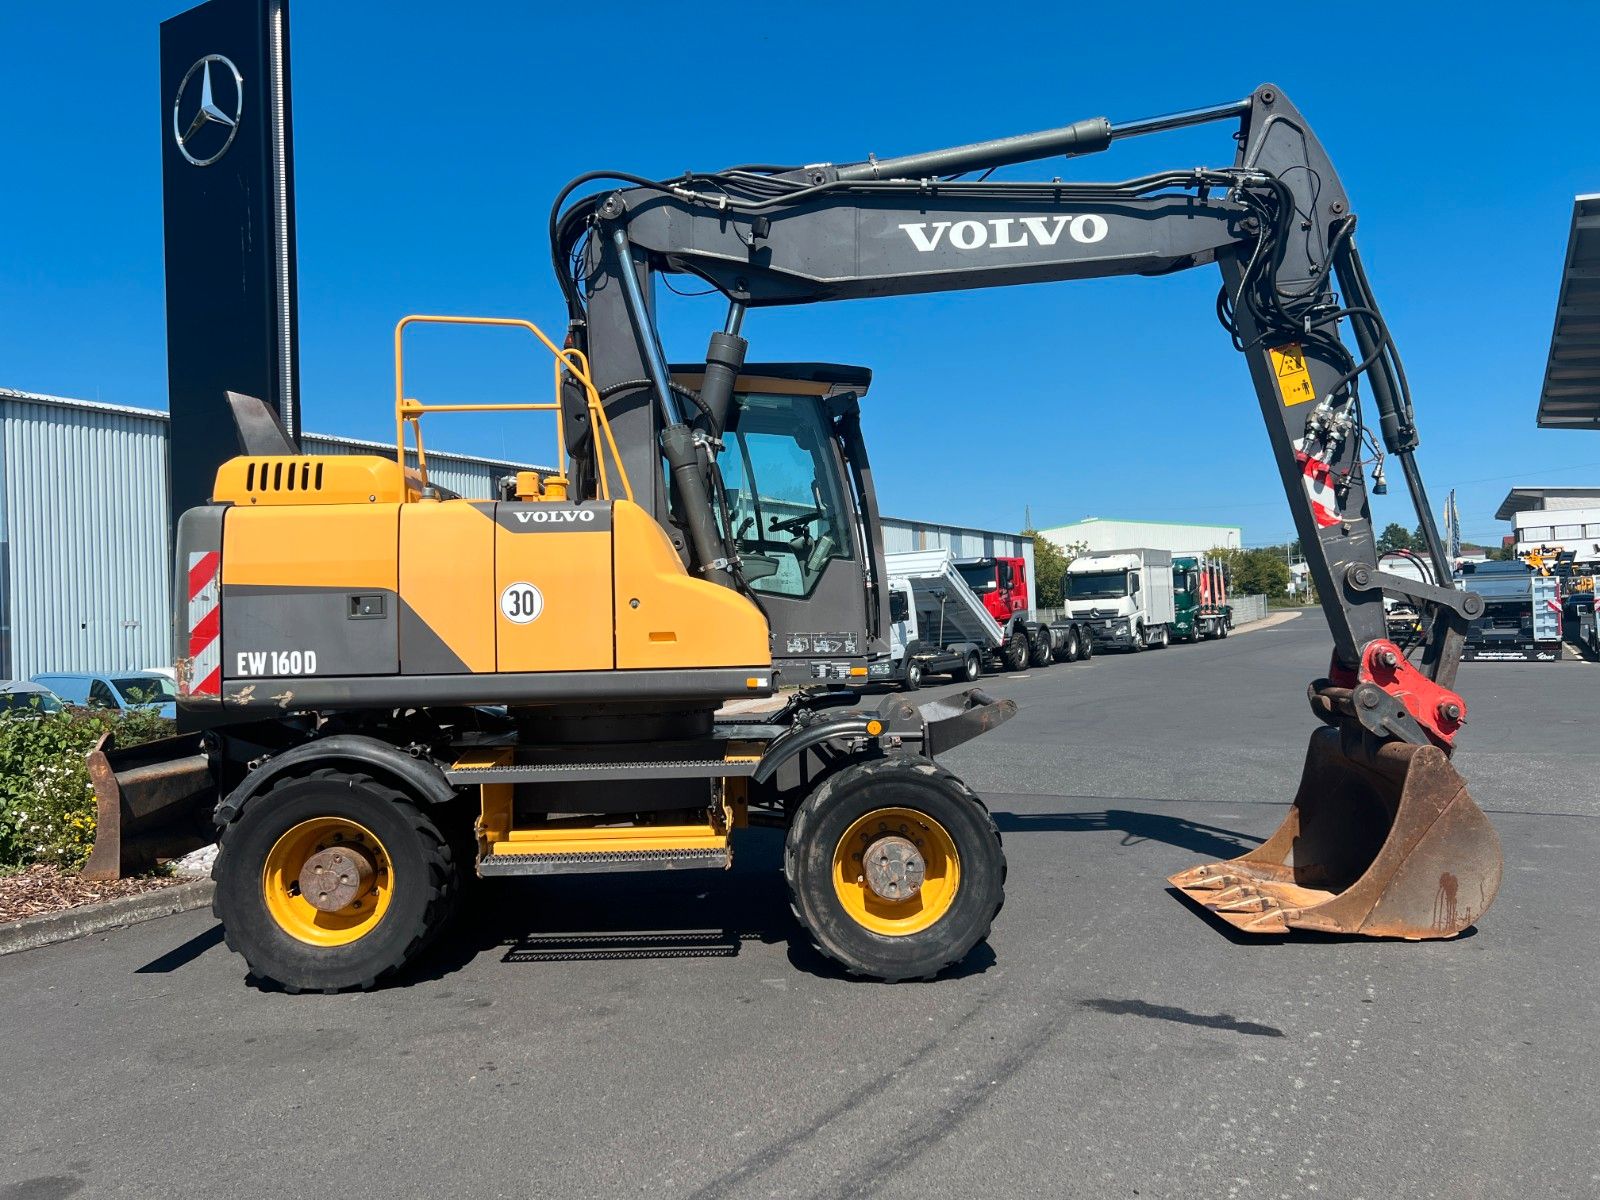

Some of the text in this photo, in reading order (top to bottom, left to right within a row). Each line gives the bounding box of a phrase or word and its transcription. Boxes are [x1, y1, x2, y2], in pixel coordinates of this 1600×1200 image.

[898, 213, 1109, 252] VOLVO
[513, 510, 595, 523] VOLVO
[509, 590, 534, 616] 30
[237, 652, 267, 676] EW
